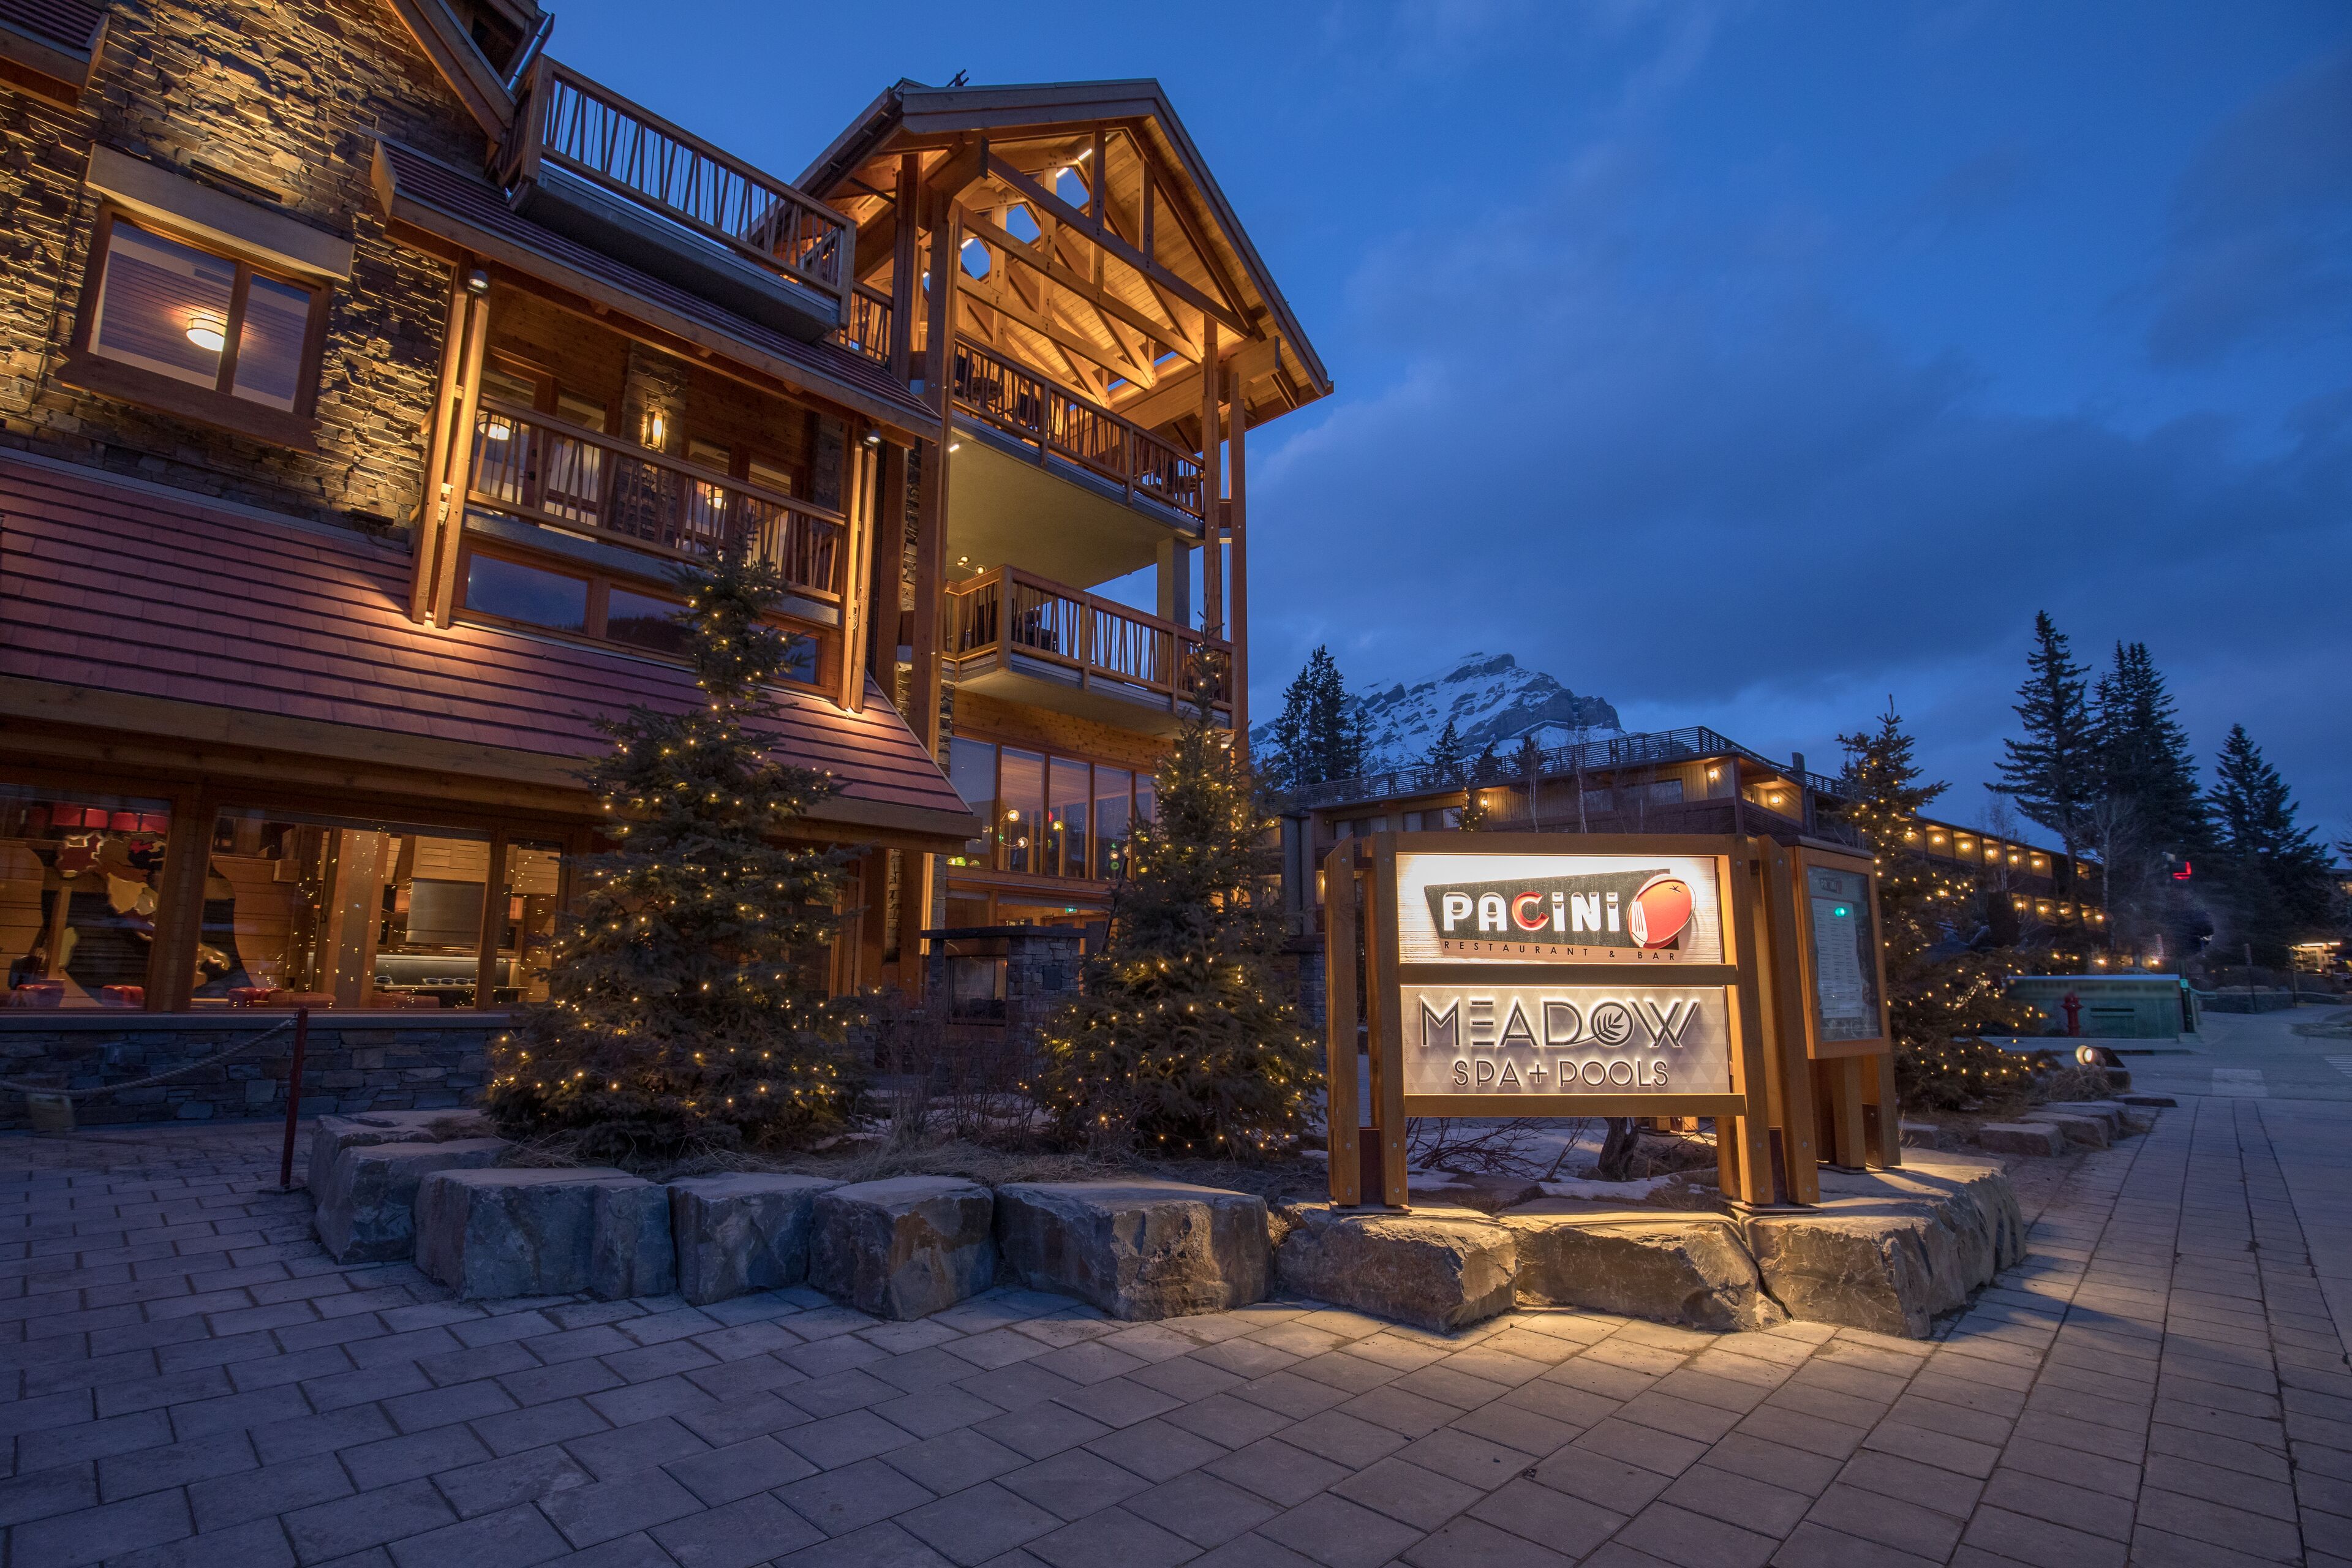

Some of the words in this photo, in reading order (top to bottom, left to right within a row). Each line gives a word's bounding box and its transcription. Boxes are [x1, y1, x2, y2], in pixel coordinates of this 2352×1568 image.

[1444, 941, 1589, 956] RESTAURANT
[1608, 950, 1616, 959] &
[1637, 950, 1676, 961] BAR
[1418, 996, 1701, 1047] MEADOW
[1453, 1058, 1521, 1087] SPA
[1558, 1058, 1670, 1088] POOLS
